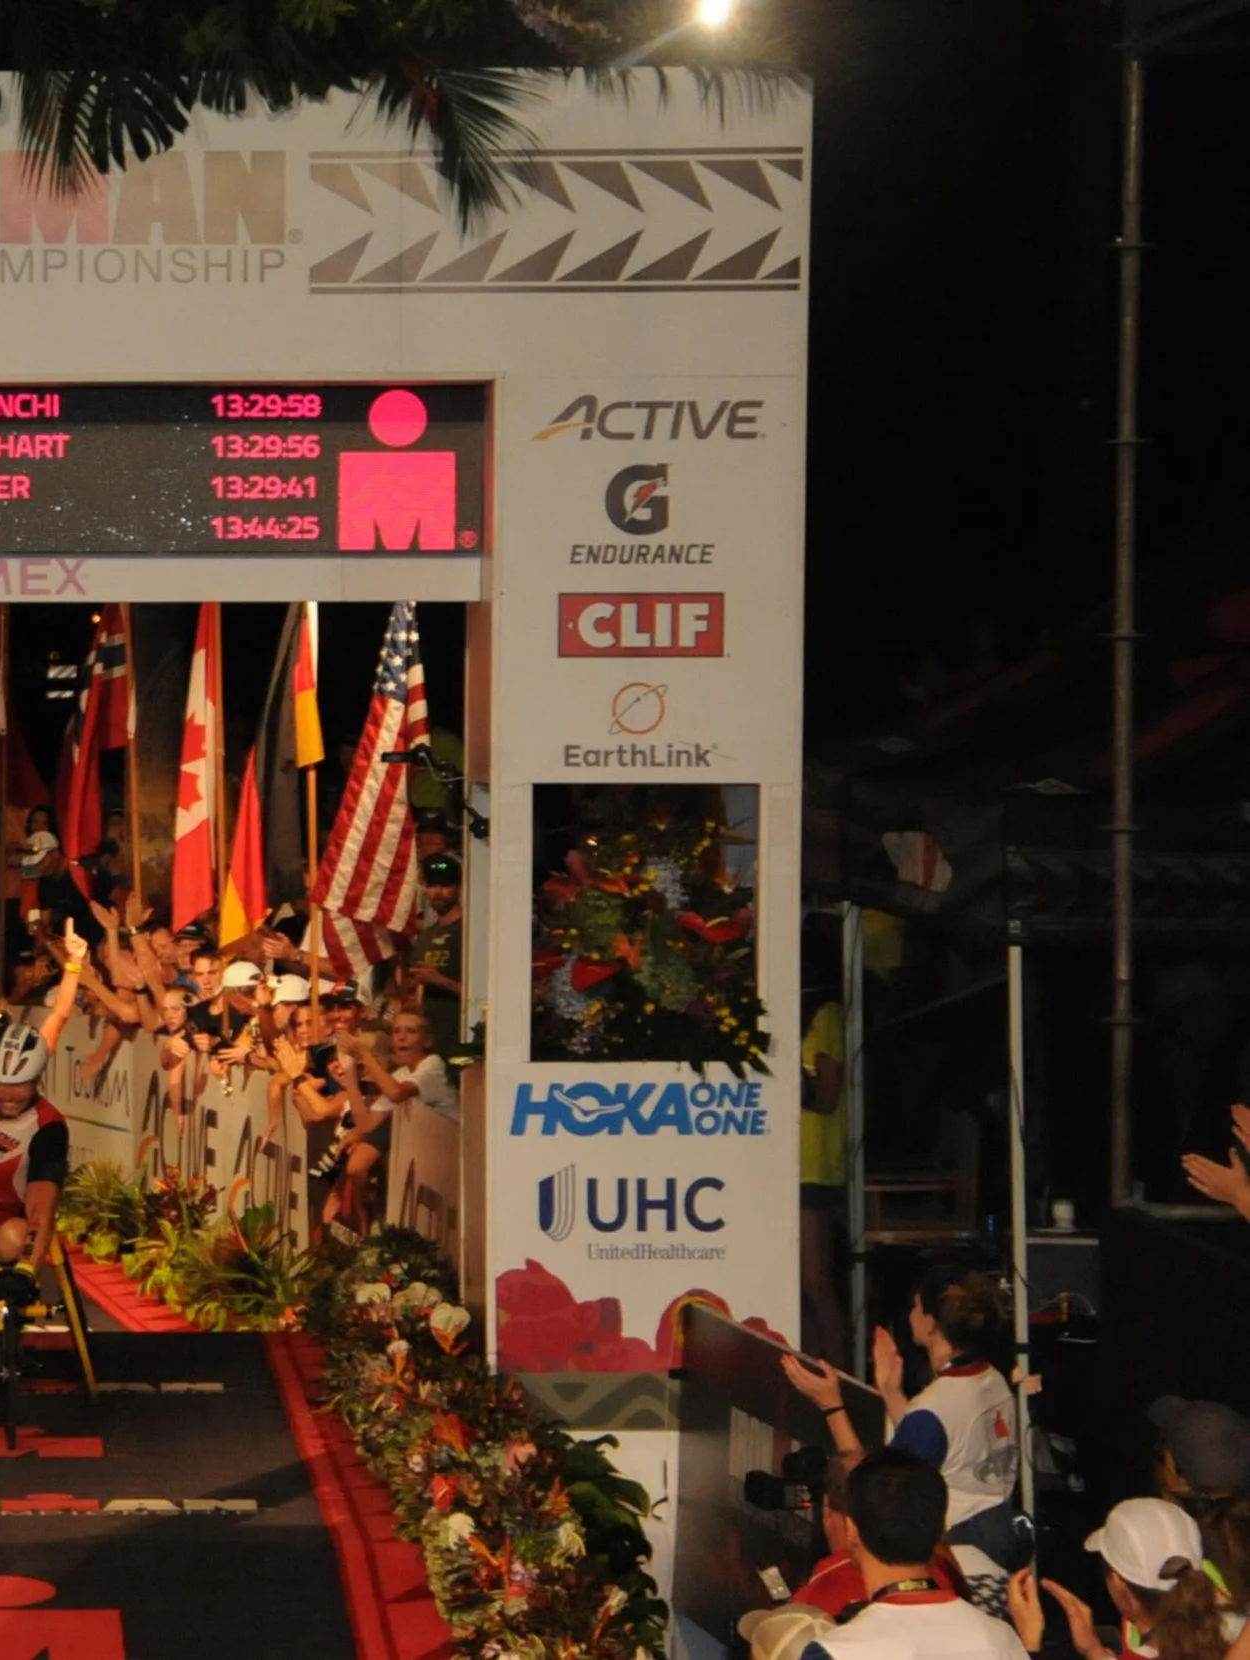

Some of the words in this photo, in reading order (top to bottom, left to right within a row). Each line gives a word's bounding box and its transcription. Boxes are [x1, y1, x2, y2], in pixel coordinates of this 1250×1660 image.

[211, 394, 322, 418] 13:29:58
[532, 394, 765, 441] ACTIVE
[211, 435, 321, 459] 13:29:56
[211, 476, 317, 500] 13:29:41
[211, 516, 320, 540] 13:44:25
[569, 543, 715, 565] ENDURANCE
[578, 602, 709, 649] CLIF
[563, 744, 712, 768] EarthLink
[510, 1082, 693, 1137] HOKA
[690, 1082, 763, 1108] ONE
[694, 1109, 768, 1136] ONE
[586, 1176, 727, 1233] UHC
[586, 1243, 727, 1261] UnitedHealthcare
